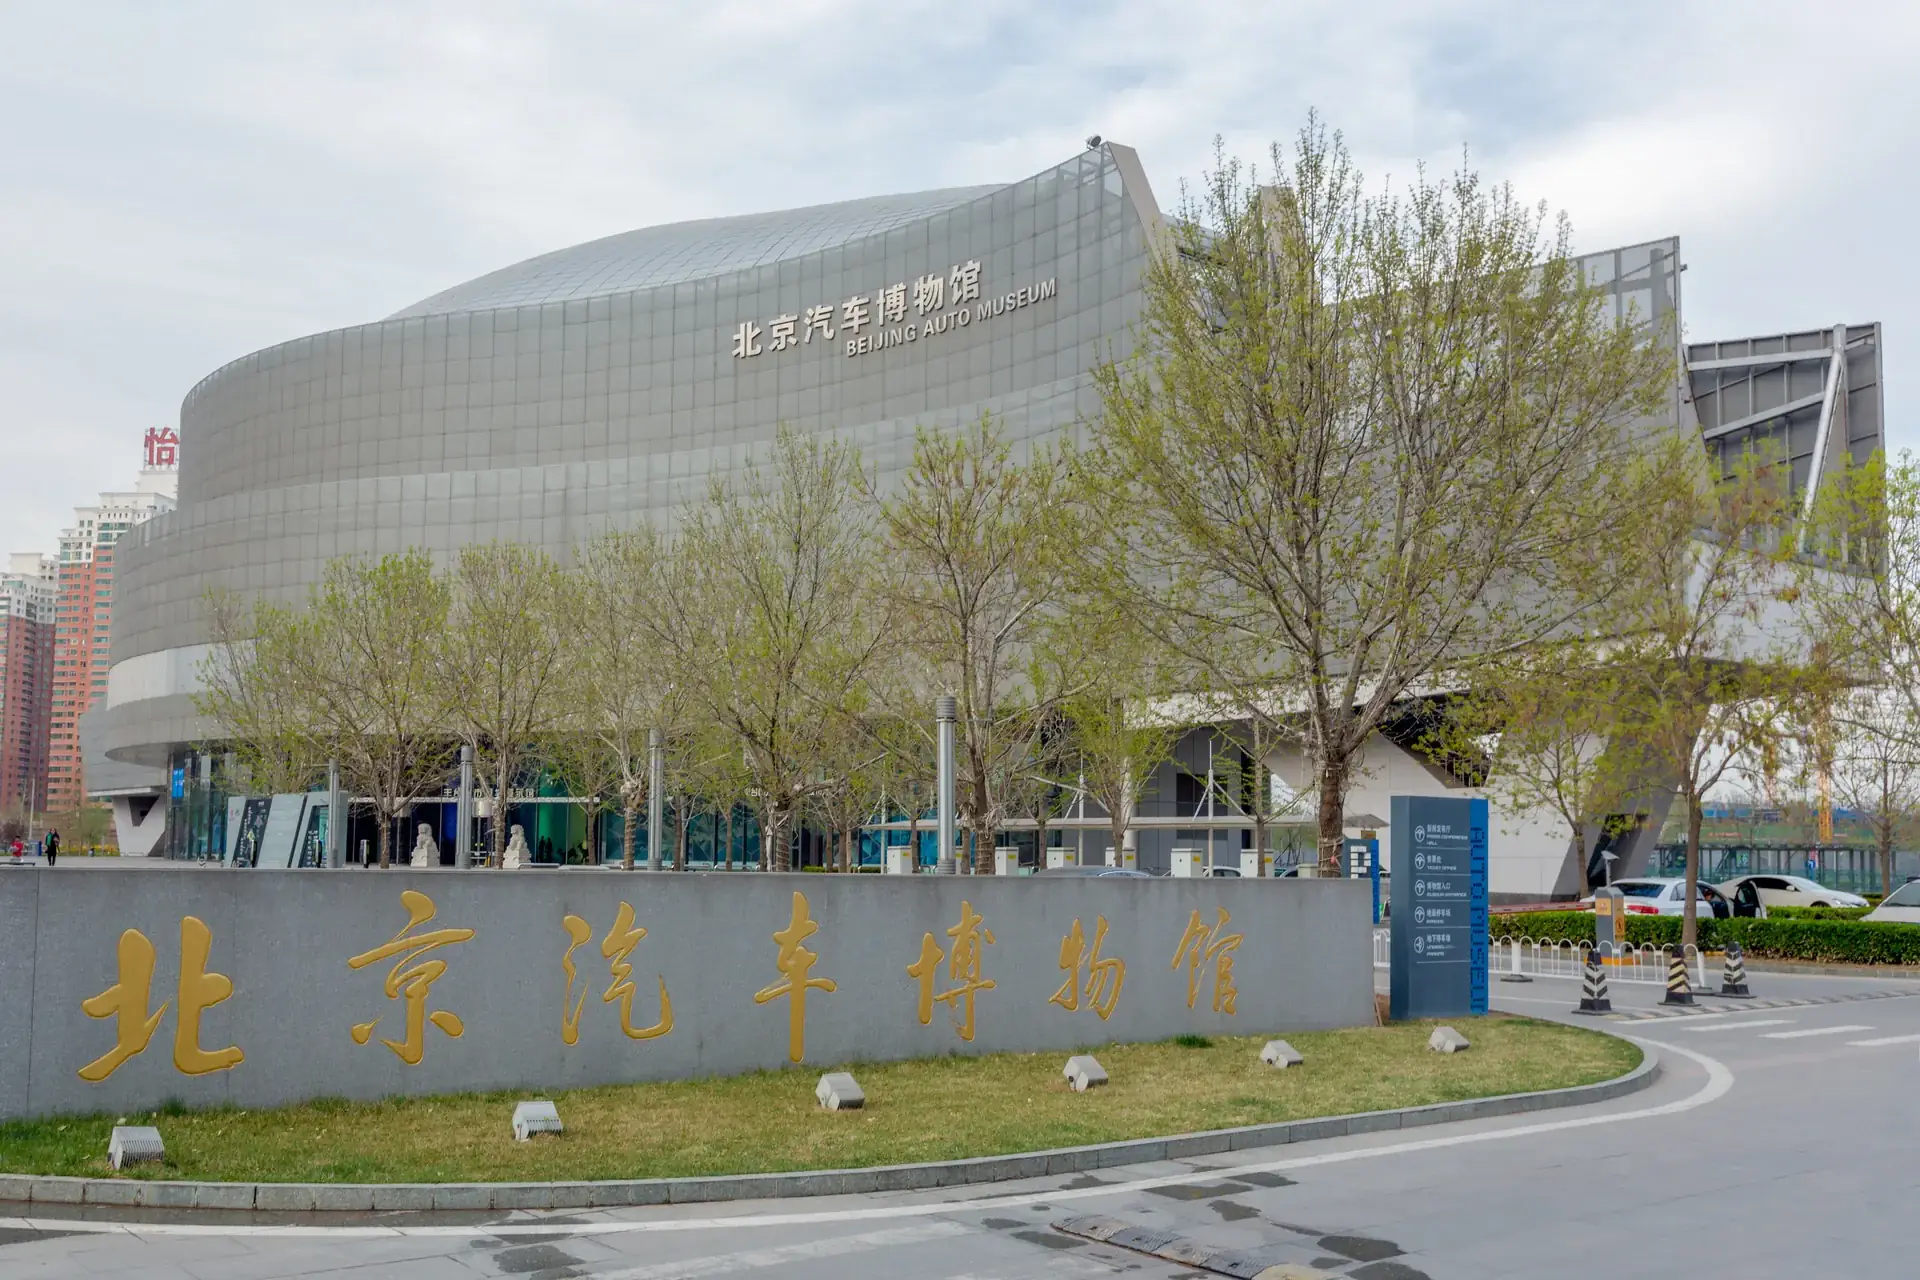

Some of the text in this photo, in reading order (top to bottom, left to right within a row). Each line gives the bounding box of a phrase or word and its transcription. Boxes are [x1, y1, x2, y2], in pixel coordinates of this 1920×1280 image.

[731, 259, 983, 359] 北京汽车博物馆
[846, 277, 1058, 358] BEIJING AUTO MUSEUM
[144, 426, 180, 466] 怡
[1350, 845, 1372, 879] P
[1470, 827, 1485, 900] AUTO
[76, 889, 1244, 1082] 北京汽车博物馆
